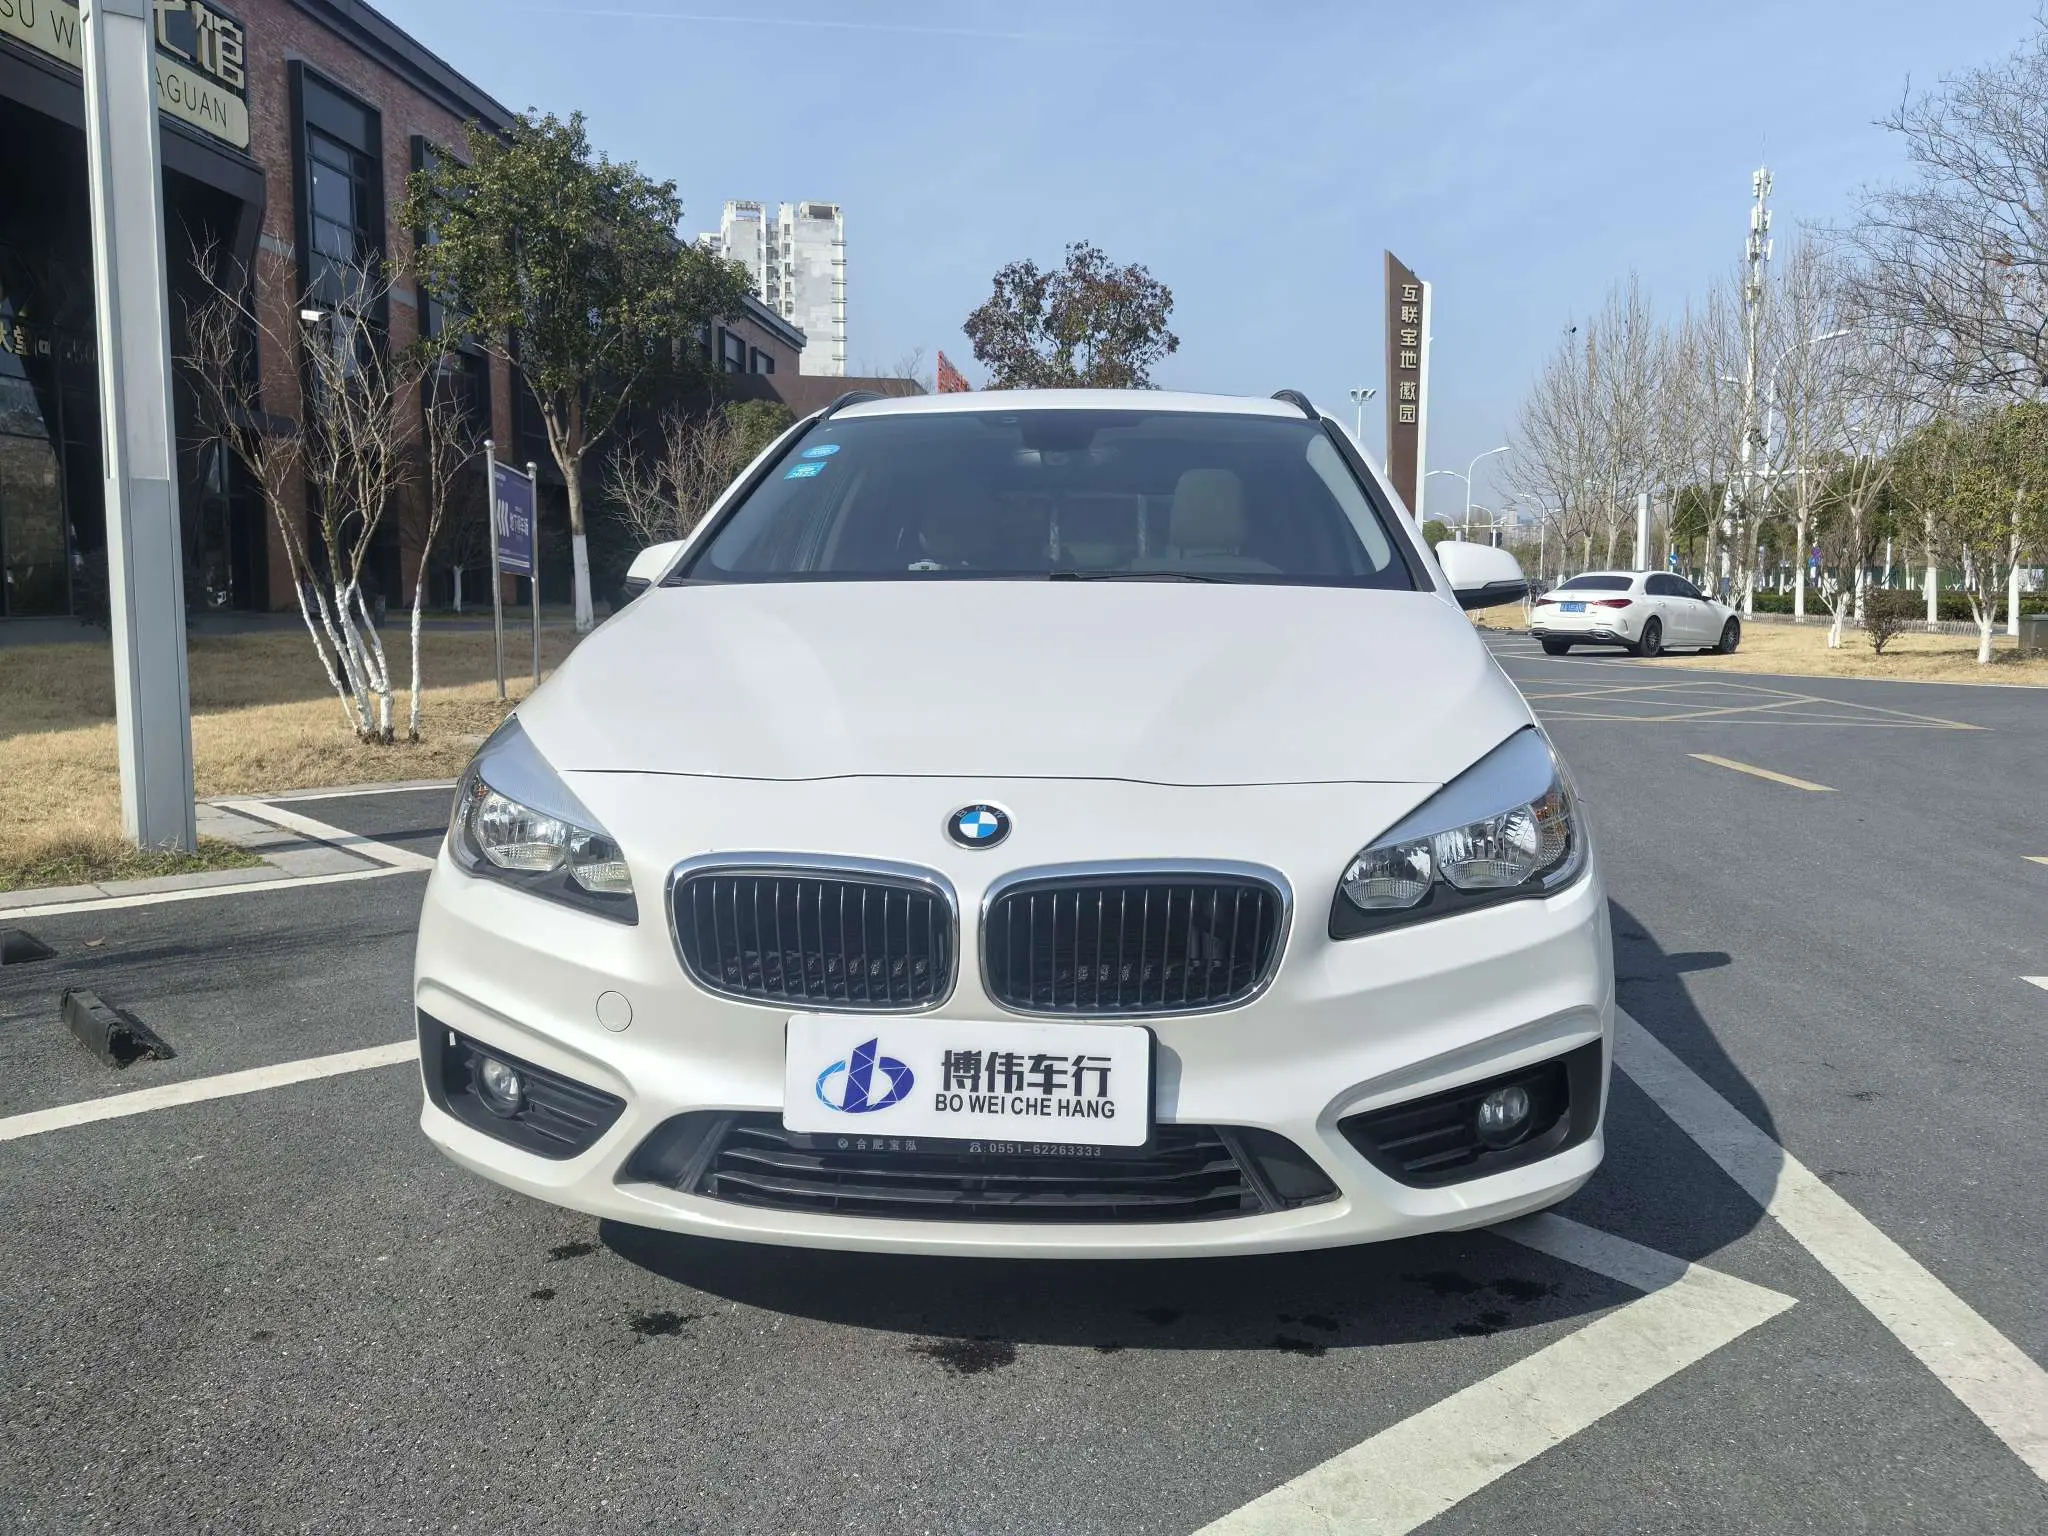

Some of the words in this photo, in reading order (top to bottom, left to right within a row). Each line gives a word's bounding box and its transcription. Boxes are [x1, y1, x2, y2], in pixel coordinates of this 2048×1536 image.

[1400, 284, 1418, 369] 互联宝地
[1399, 381, 1416, 423] 徽园
[955, 805, 1006, 819] BMW
[941, 1049, 1112, 1098] 博伟车行
[935, 1093, 963, 1113] BO
[970, 1095, 1005, 1115] WEI
[1011, 1097, 1051, 1117] CHE
[1058, 1099, 1116, 1120] HANG
